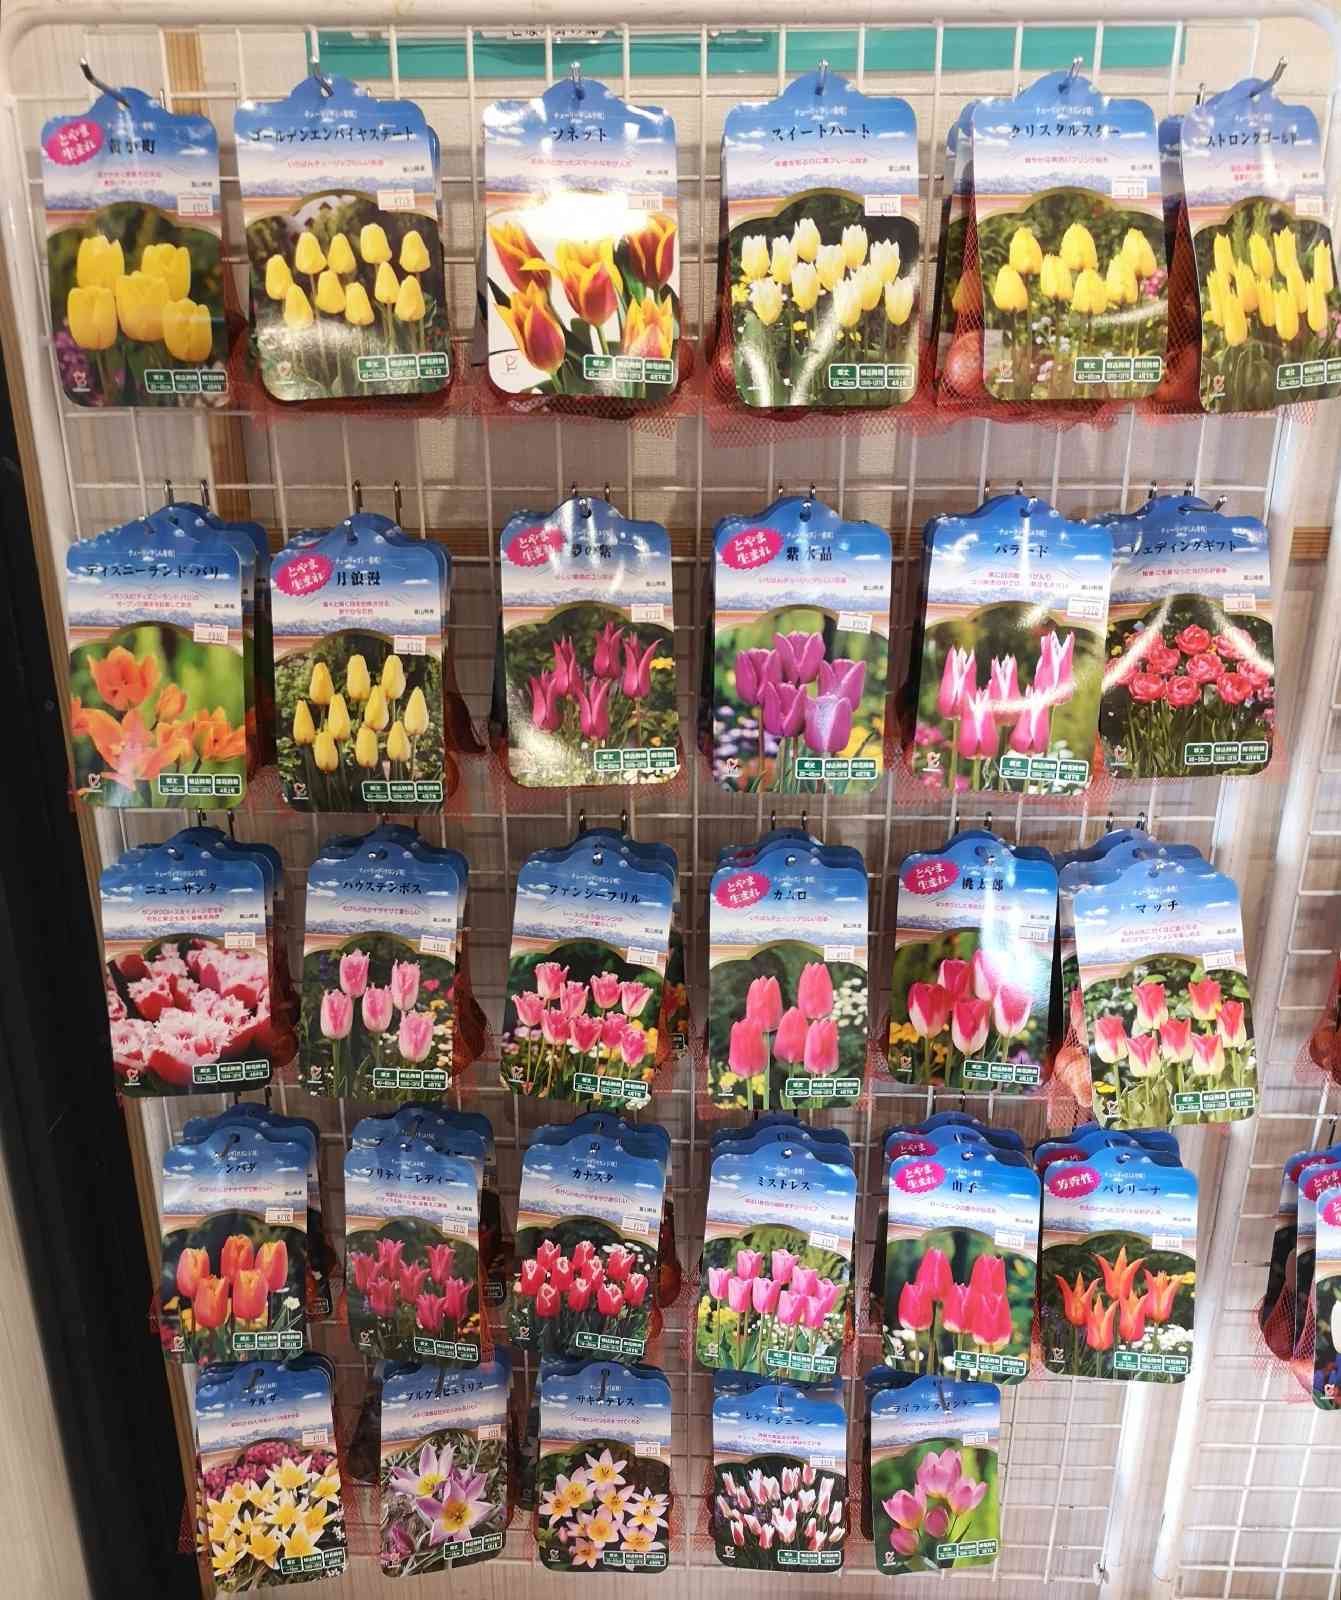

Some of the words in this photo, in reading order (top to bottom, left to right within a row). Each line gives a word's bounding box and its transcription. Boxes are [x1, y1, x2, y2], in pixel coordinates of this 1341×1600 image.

[58, 124, 91, 147] とやま
[551, 126, 609, 143] ソネット
[771, 123, 872, 141] スイートハート
[1010, 123, 1121, 138] クリスタルスター
[61, 140, 97, 161] 生まれ
[519, 531, 551, 550] とやま
[735, 531, 768, 552] とやま
[737, 547, 772, 564] 生まれ
[288, 558, 320, 578] とやま
[291, 571, 325, 591] 生まれ
[915, 863, 946, 879] とやま
[144, 882, 218, 896] ニューサンタ
[342, 880, 423, 896] ハウステンボス
[727, 875, 757, 893] とやま
[917, 876, 950, 890] 生まれ
[549, 883, 641, 905] ファンシーフリル
[729, 889, 761, 904] 生まれ
[1135, 899, 1179, 914] マッチ
[571, 1168, 616, 1184] カナスタ
[905, 1164, 934, 1179] とやま
[757, 1175, 811, 1192] ミストレス
[907, 1176, 938, 1189] 生まれ
[1102, 1183, 1162, 1196] バレリーナ
